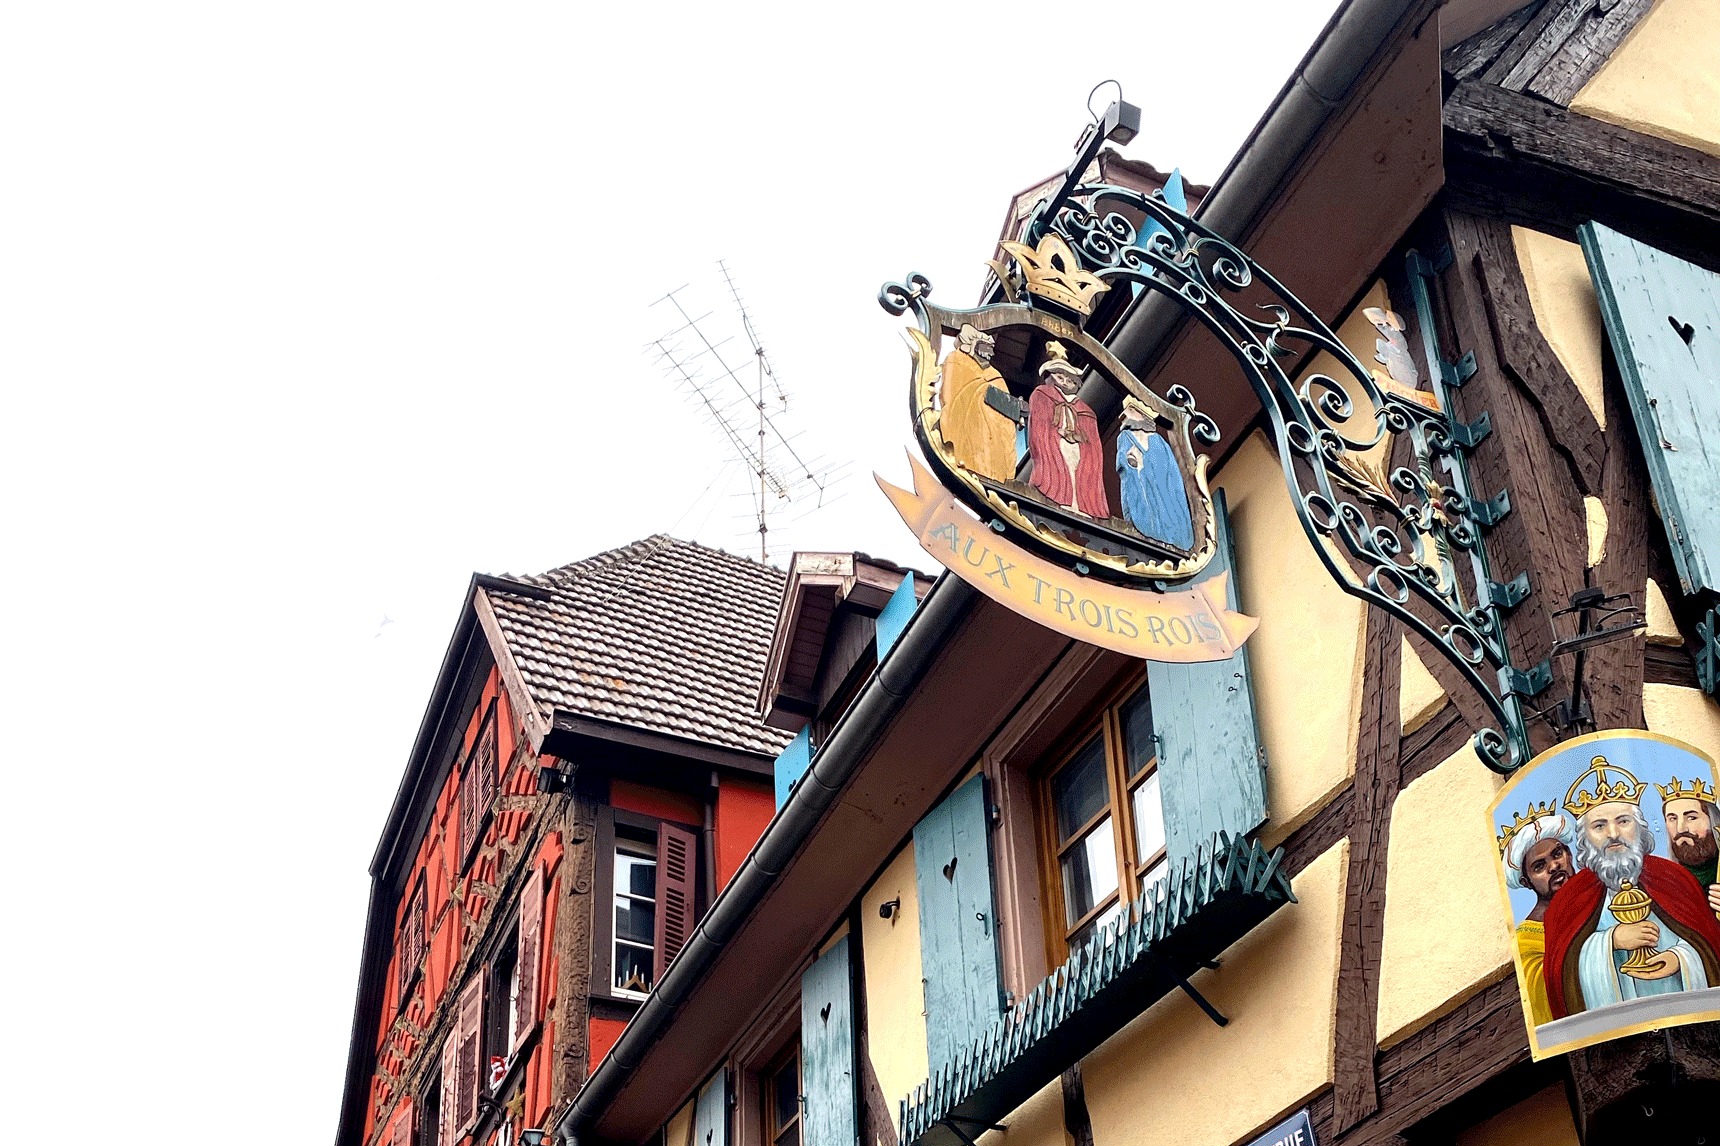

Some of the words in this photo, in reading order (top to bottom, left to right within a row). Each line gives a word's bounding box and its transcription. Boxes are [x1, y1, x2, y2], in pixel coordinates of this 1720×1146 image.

[929, 522, 1012, 589] AUX
[1026, 572, 1139, 639] TROIS
[1145, 611, 1223, 648] ROIS
